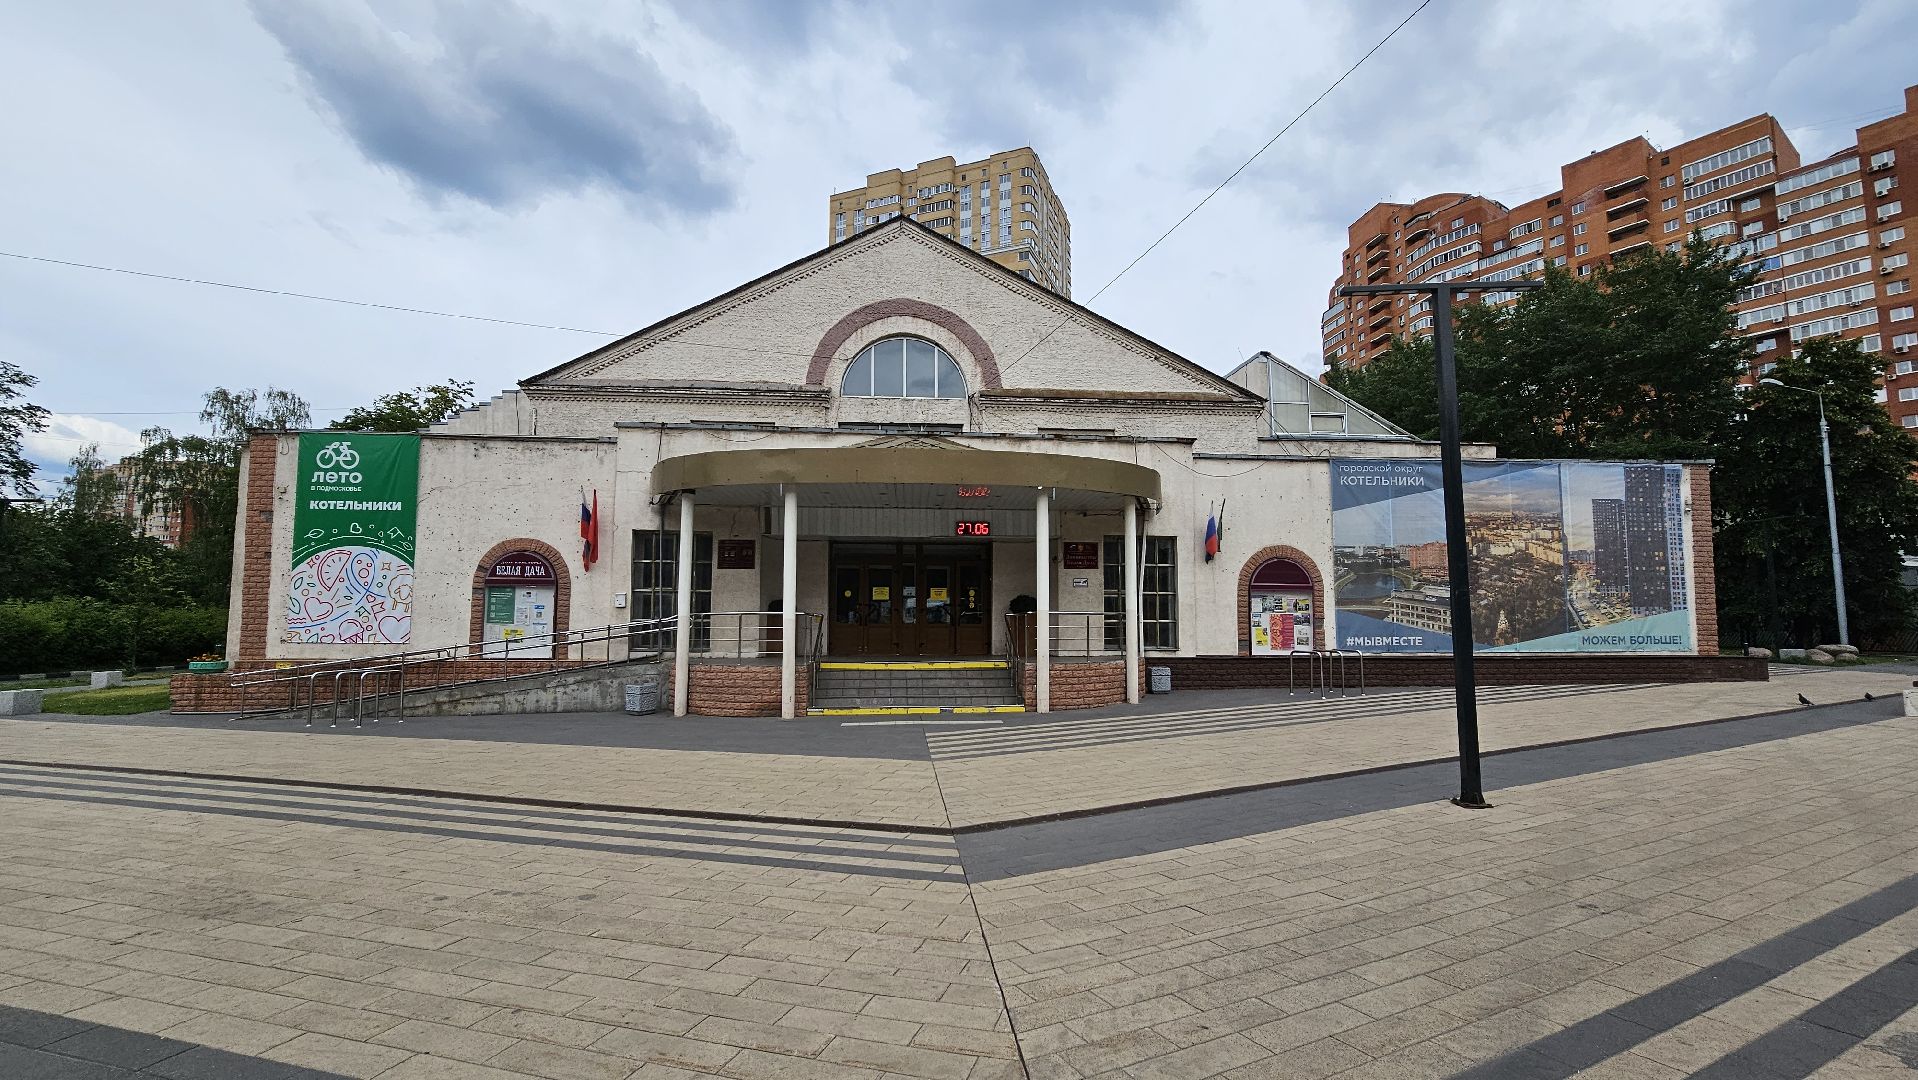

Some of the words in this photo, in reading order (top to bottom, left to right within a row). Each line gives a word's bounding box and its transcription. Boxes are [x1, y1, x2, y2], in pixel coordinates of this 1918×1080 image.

[1340, 464, 1392, 473] городской
[1395, 465, 1423, 474] округ
[1340, 476, 1425, 486] КОТЕЛЬНИКИ
[309, 500, 402, 511] КОТЕЛЬНИКИ
[957, 523, 989, 535] 27.06
[496, 565, 521, 576] БЕЛАЯ
[524, 565, 546, 577] ДАЧА
[1346, 636, 1423, 646] #МЫВМЕСТЕ
[1582, 635, 1626, 645] МОЖЕМ
[1629, 635, 1682, 645] БОЛЬШЕ!
